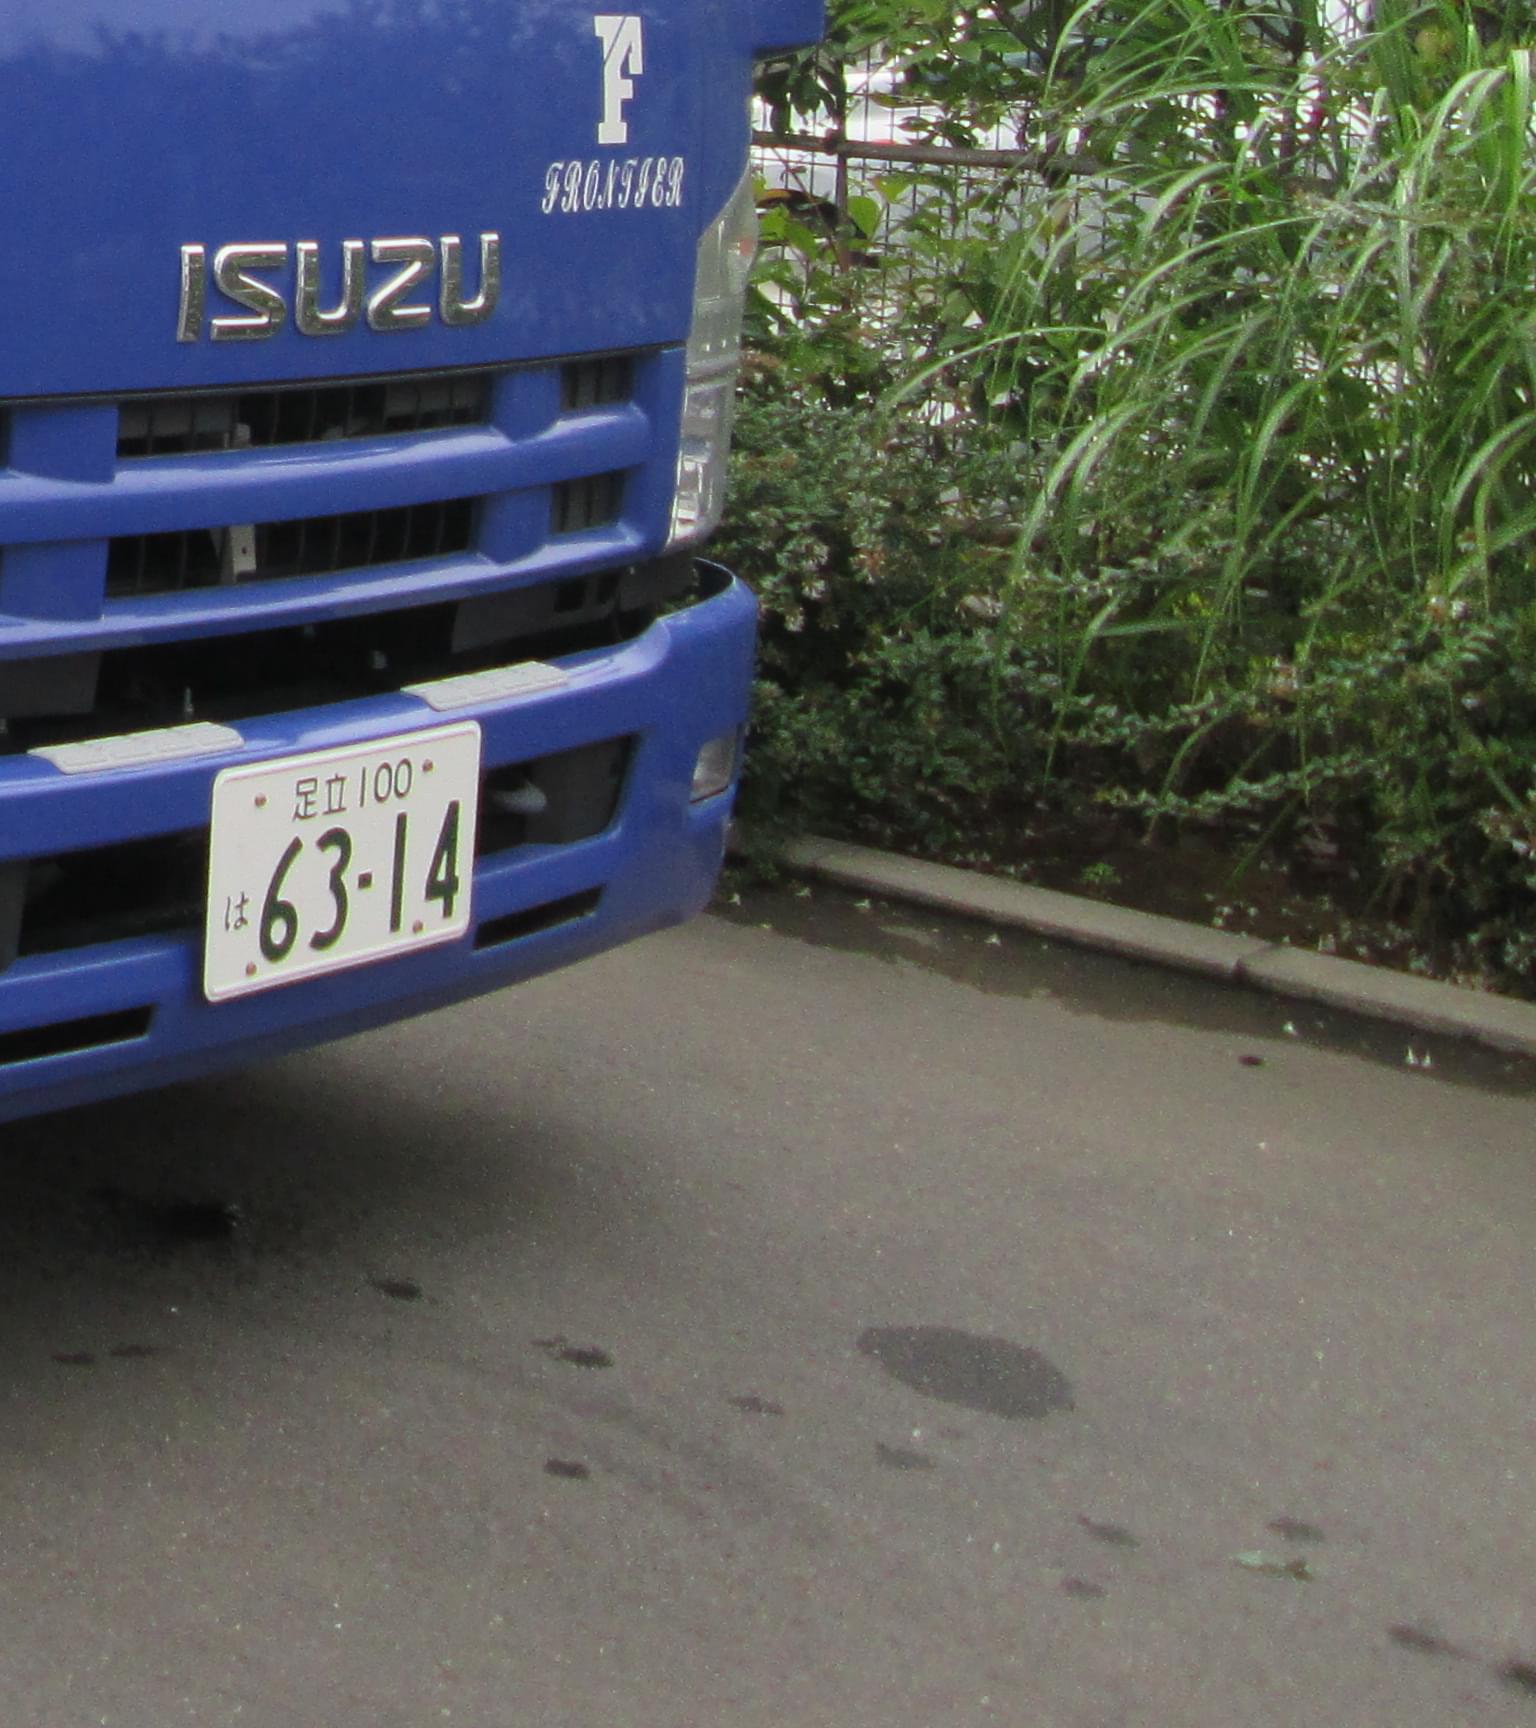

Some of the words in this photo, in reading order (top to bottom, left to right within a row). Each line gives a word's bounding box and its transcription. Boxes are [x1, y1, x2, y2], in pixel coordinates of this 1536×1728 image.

[540, 156, 685, 215] FRONTIER
[176, 231, 499, 343] ISUZU
[224, 890, 251, 933] は
[258, 799, 461, 964] 63-14
